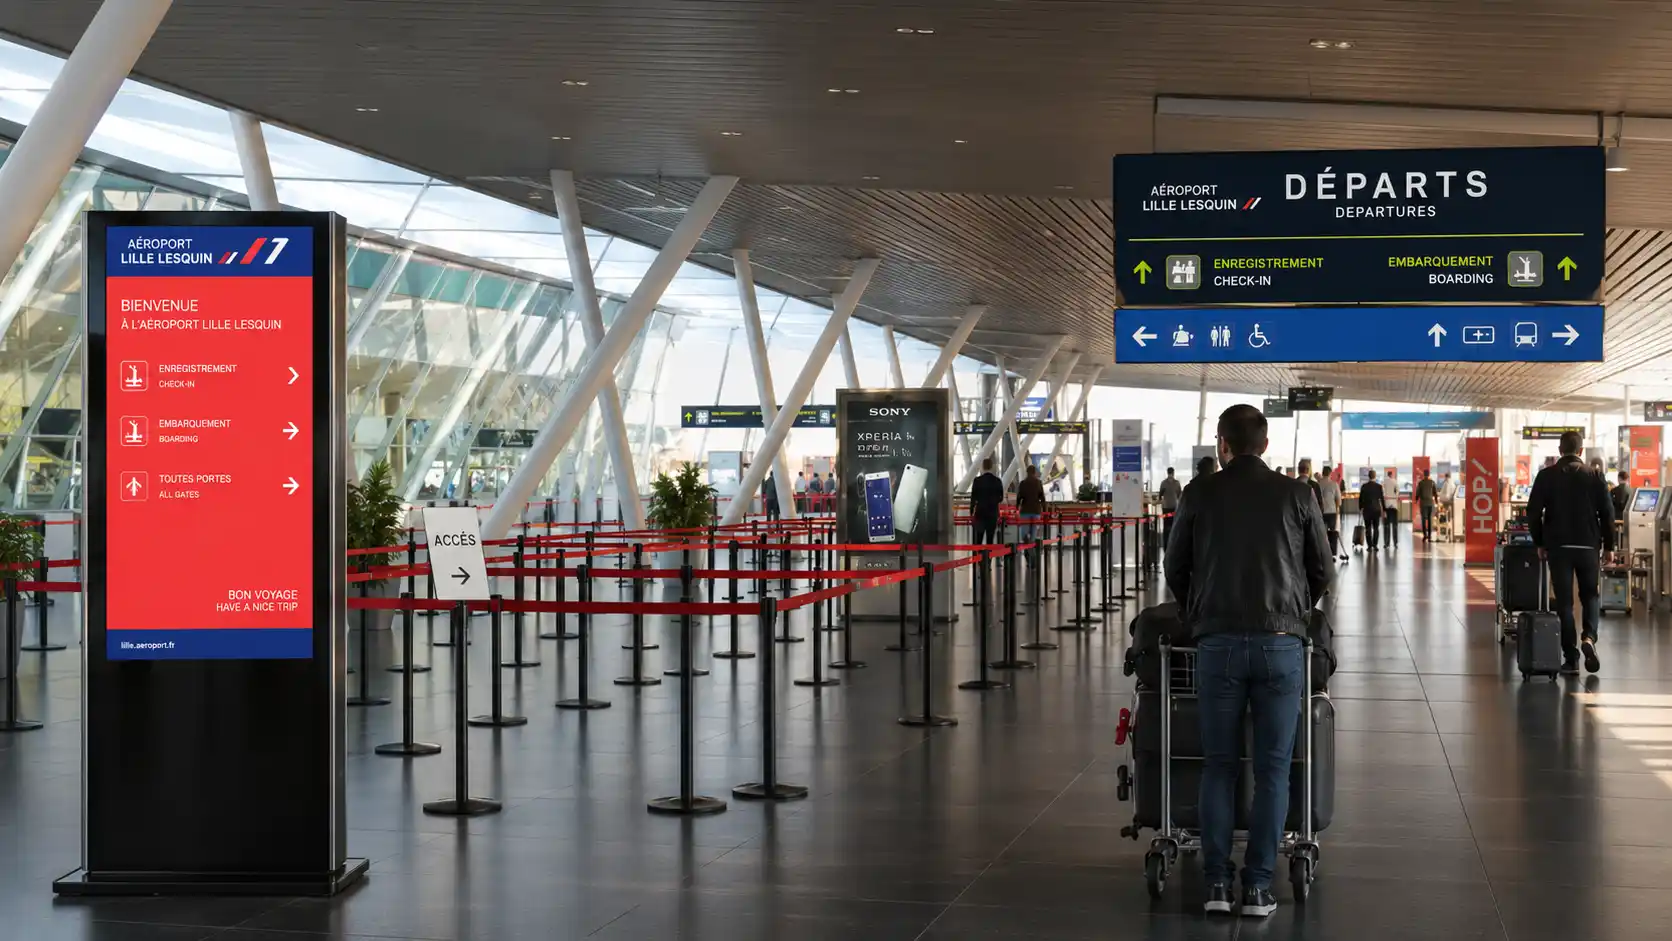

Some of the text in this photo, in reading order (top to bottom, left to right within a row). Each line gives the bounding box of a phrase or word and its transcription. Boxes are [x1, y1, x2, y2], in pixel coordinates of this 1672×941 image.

[1286, 167, 1487, 199] DÉPARTS
[1151, 183, 1217, 196] AÉROPORT
[1143, 199, 1236, 210] LILLE LESQUIN
[1336, 206, 1435, 218] DEPARTURES
[128, 236, 192, 249] AÉROPORT
[122, 253, 212, 264] LILLE LESQUIN
[1215, 258, 1323, 268] ENREGISTREMENT
[1389, 256, 1493, 267] EMBARQUEMENT
[1214, 276, 1270, 286] CHECK-IN
[1429, 274, 1493, 283] BOARDING
[122, 299, 198, 311] BIENVENUE
[203, 320, 230, 329] LILLE
[235, 320, 281, 330] LESQUIN
[159, 364, 237, 373] ENREGISTREMENT
[159, 379, 195, 388] CHECK-IN
[869, 408, 911, 416] SONY
[159, 420, 231, 428] EMBARQUEMENT
[159, 435, 198, 443] BOARDING
[857, 432, 902, 441] XPERIA
[159, 474, 231, 483] TOUTES PORTES
[159, 491, 199, 499] ALL GATES
[1471, 458, 1493, 533] HOP!
[228, 590, 297, 600] BON VOYAGE
[217, 602, 298, 612] HAVE A NICE TRIP
[120, 641, 175, 650] lille.aeroport.fr
